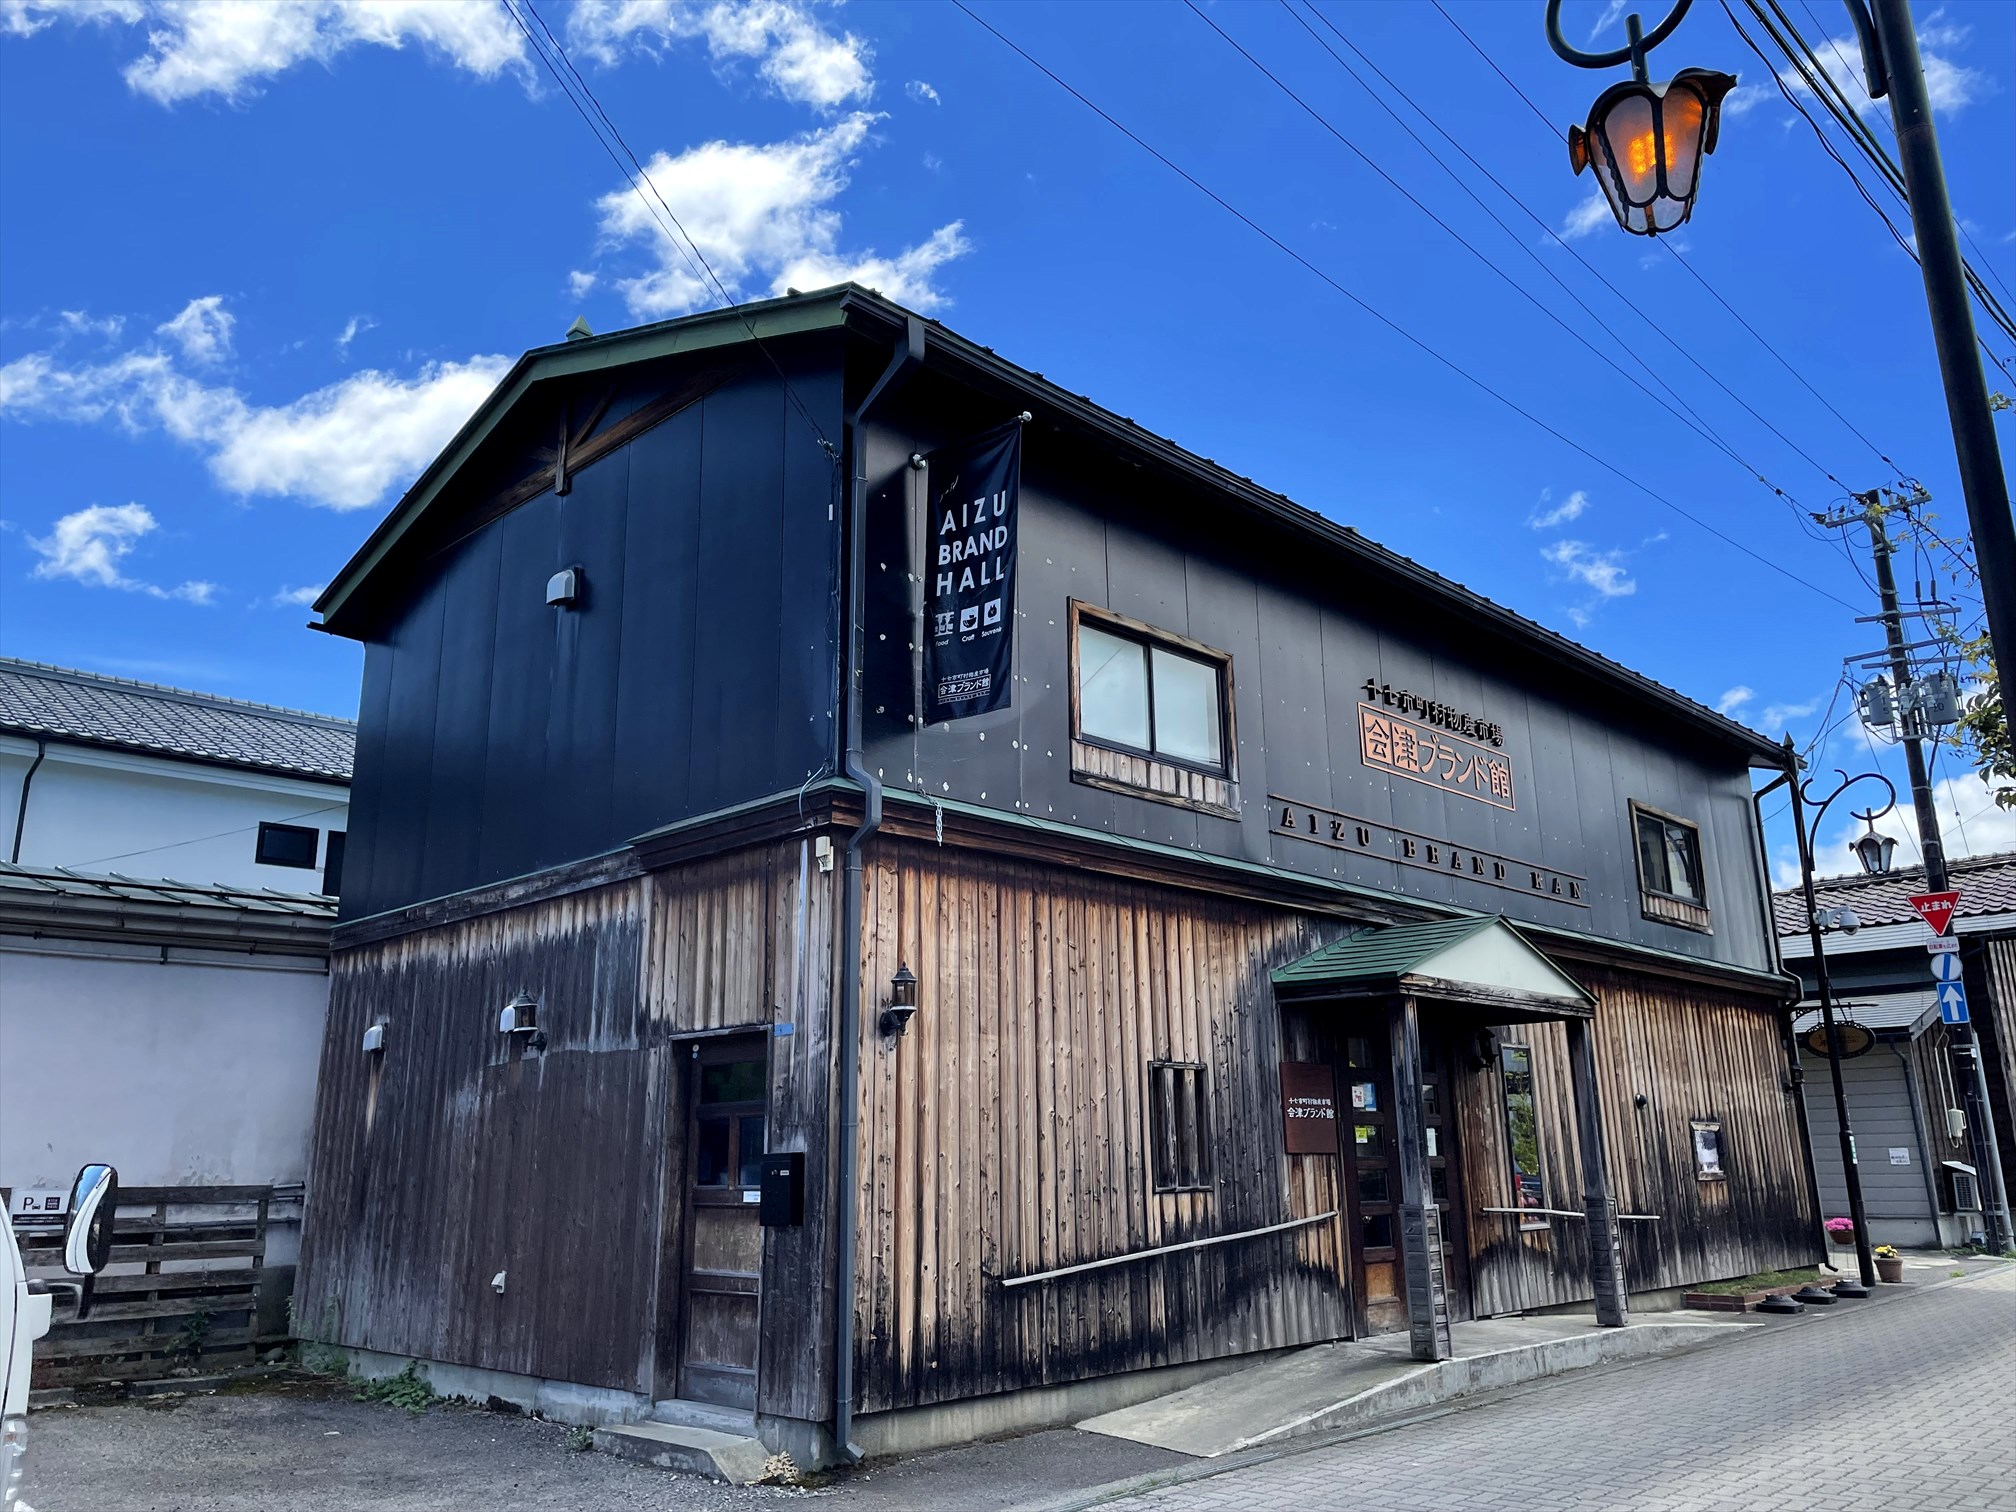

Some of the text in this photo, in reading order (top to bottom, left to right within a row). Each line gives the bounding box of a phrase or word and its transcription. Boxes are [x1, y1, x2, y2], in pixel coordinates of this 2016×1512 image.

[940, 490, 1006, 535] AIZU
[938, 525, 1008, 566] BRAND
[936, 556, 1004, 597] HALL
[940, 677, 990, 695] 会津ブランド館
[1361, 677, 1504, 747] 十七市町村物産市場
[1363, 712, 1510, 799] 会津ブランド館
[1281, 807, 1582, 900] AIZU BRAND KAN
[1920, 899, 1953, 913] 止まれ
[1287, 1106, 1335, 1119] 会津ブランド館
[23, 1196, 34, 1211] P
